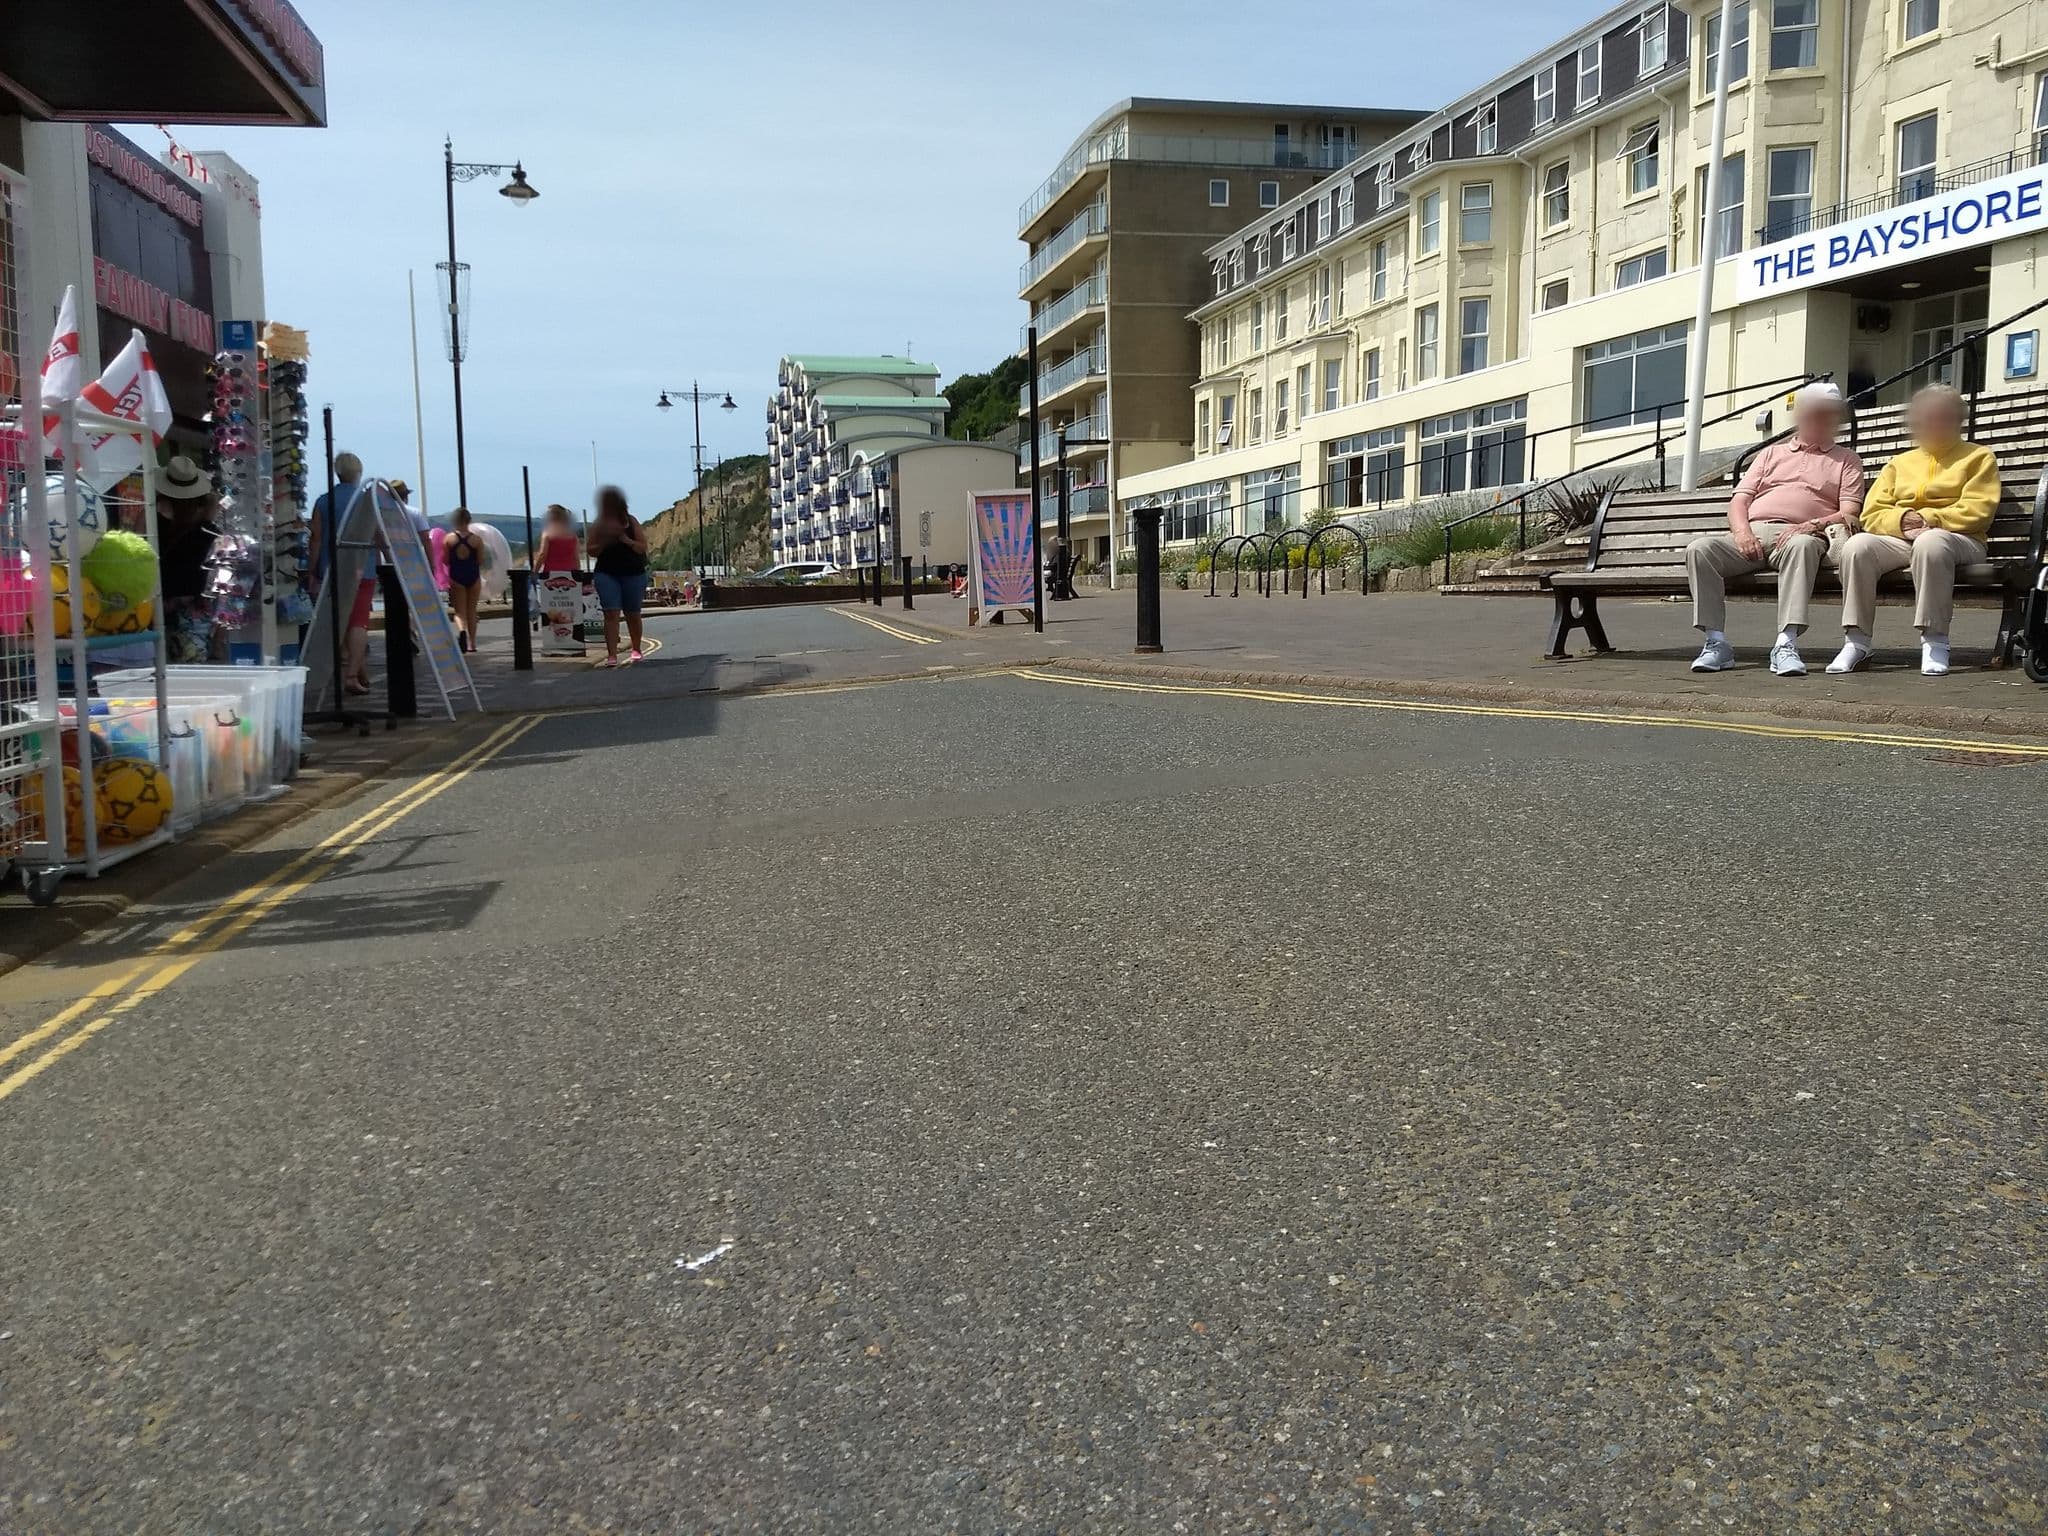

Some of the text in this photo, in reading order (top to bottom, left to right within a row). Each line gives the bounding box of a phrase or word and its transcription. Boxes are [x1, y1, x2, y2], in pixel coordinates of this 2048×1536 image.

[85, 122, 113, 168] OST
[117, 146, 168, 204] WORLD
[1754, 179, 2043, 287] THE BAYSHORE
[93, 256, 168, 334] FAMILY
[174, 298, 215, 357] FUN
